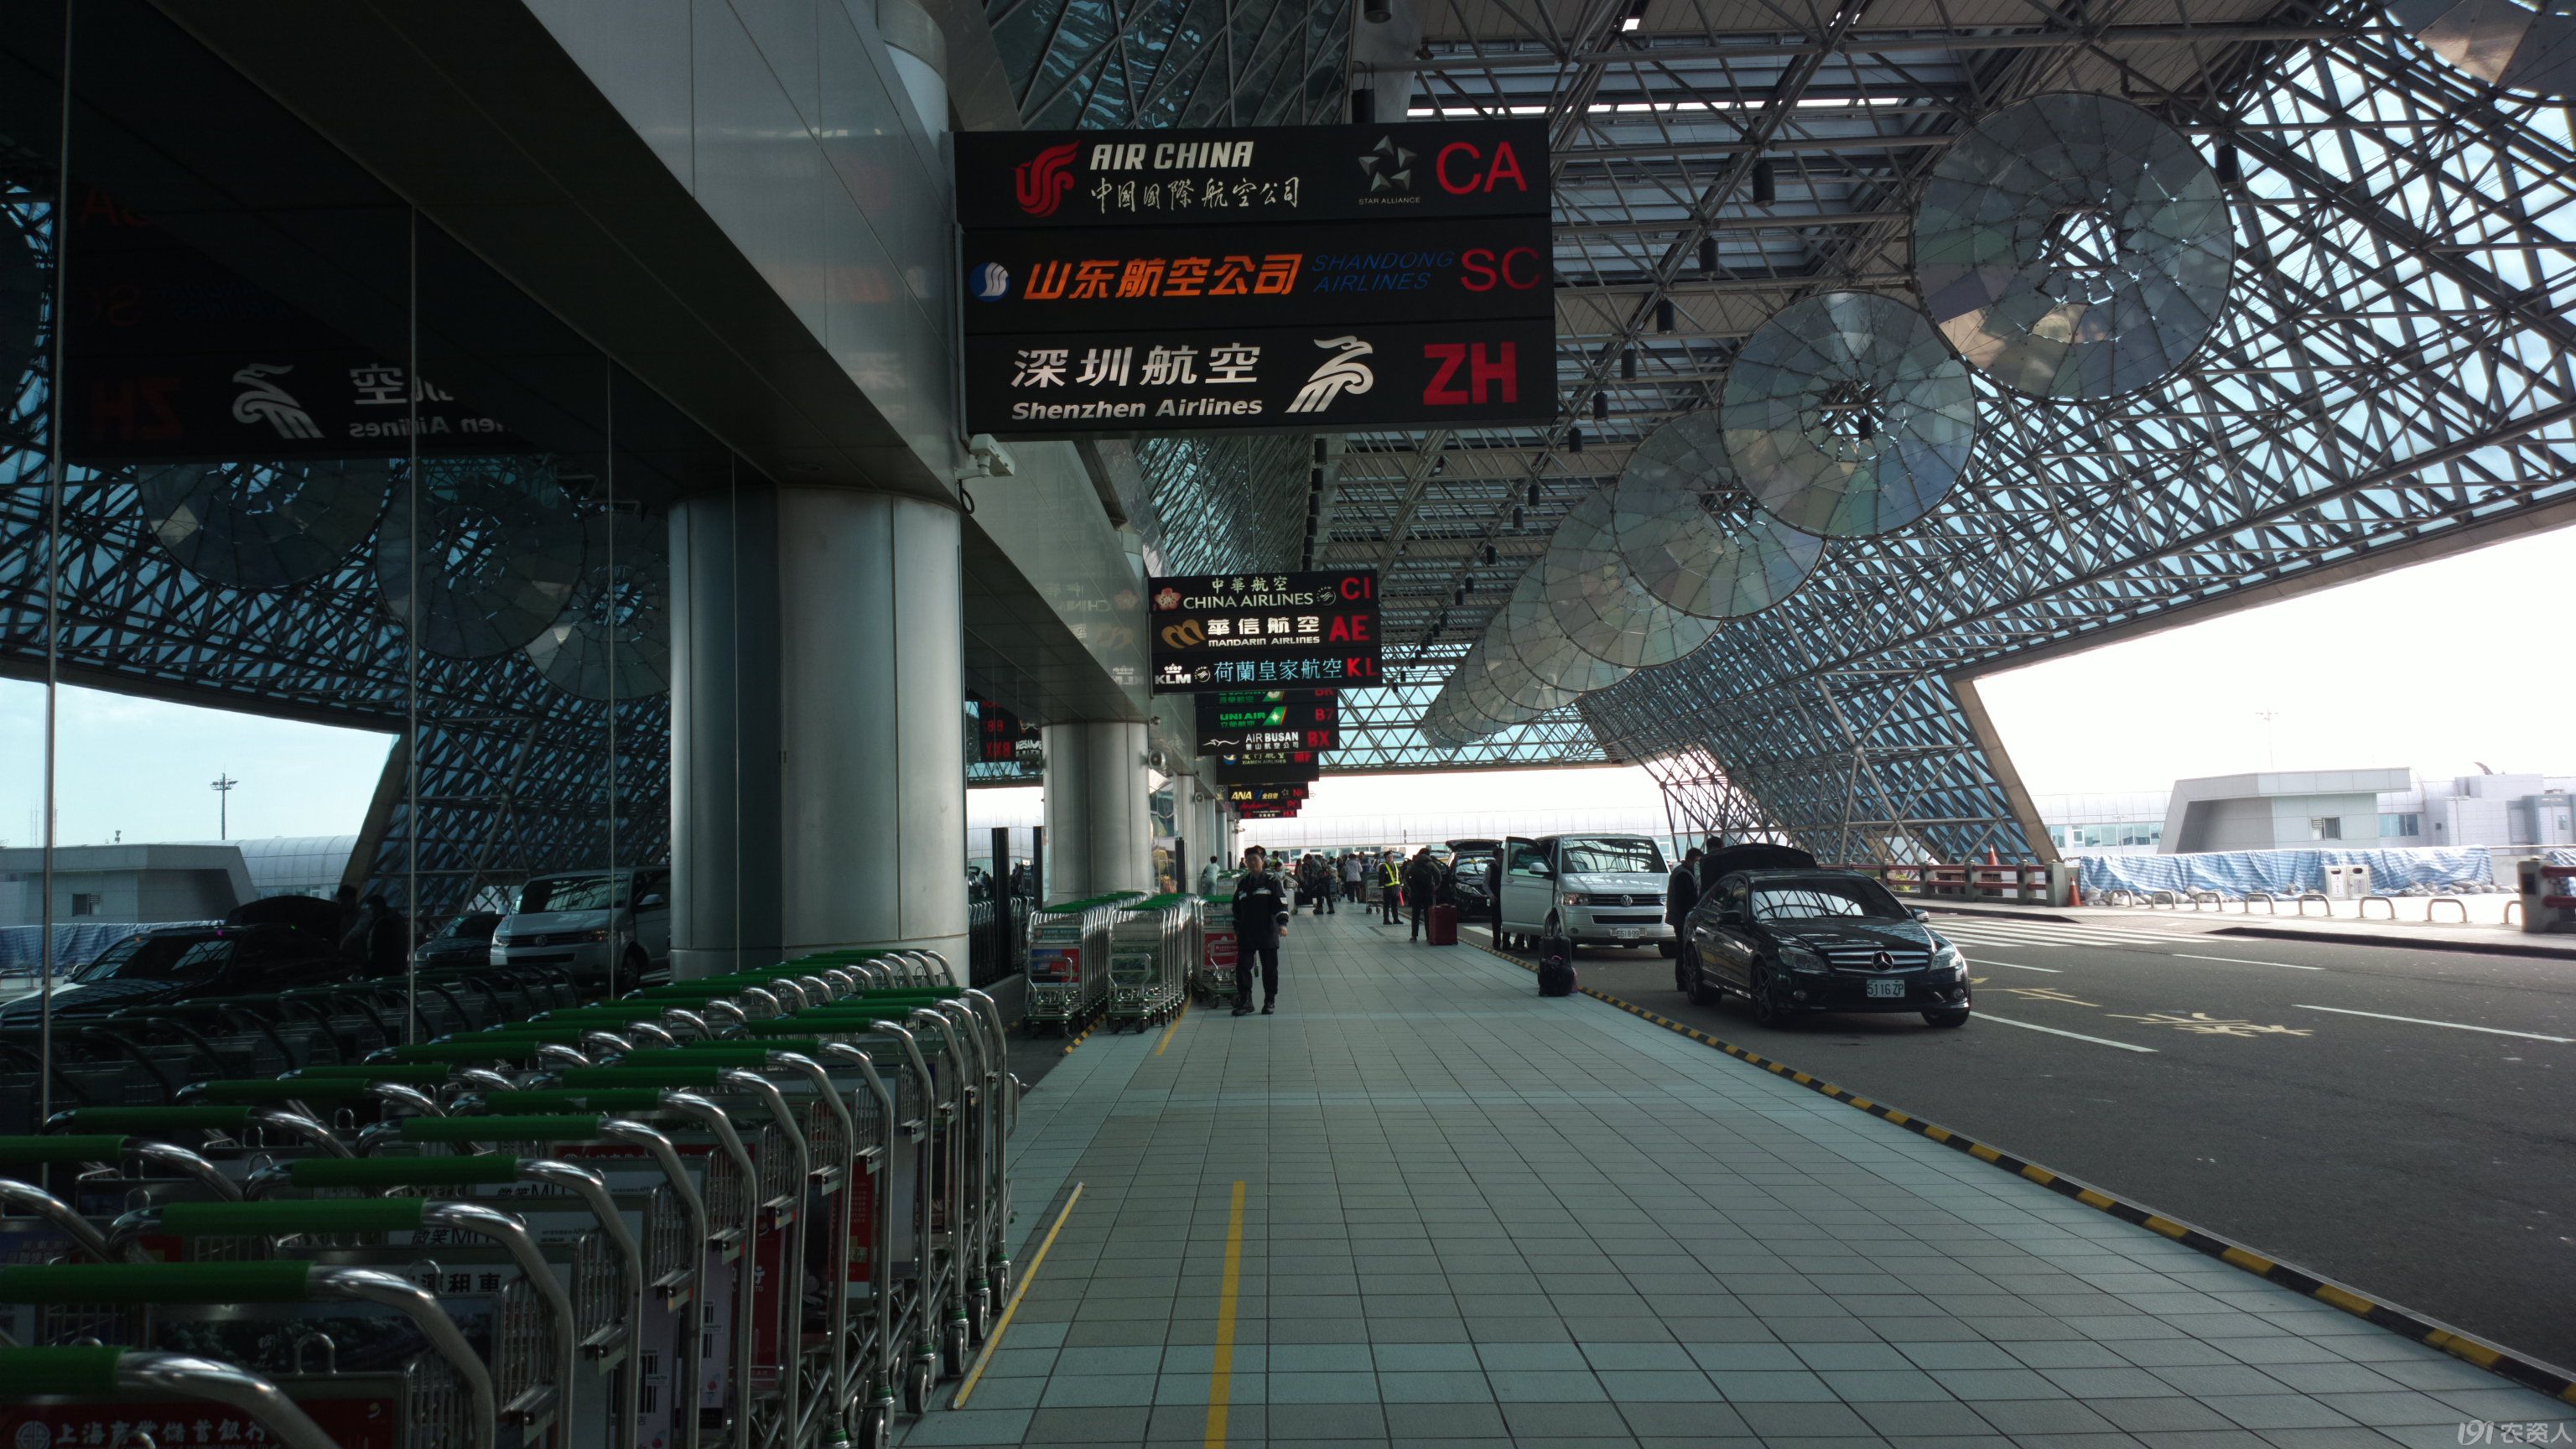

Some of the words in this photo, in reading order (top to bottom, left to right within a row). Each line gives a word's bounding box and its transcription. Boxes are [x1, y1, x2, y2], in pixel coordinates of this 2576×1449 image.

[1090, 143, 1146, 170] AIR
[1154, 141, 1254, 169] CHINA
[1436, 141, 1528, 195] CA
[1311, 251, 1455, 273] SHANDONG
[1461, 248, 1540, 292] SC
[1022, 252, 1303, 300] 山东航空公司
[1313, 271, 1431, 293] AIRLINES
[1010, 342, 1261, 388] 深圳航空
[1423, 342, 1519, 406] ZH
[1011, 401, 1146, 420] Shenzhen
[1155, 398, 1263, 417] Airlines
[1212, 576, 1288, 594] 中華航空
[1340, 577, 1372, 600] CI
[1183, 595, 1237, 610] CHINA
[1240, 592, 1314, 607] AIRLINES
[1208, 616, 1321, 636] 華信航空
[1328, 615, 1371, 642] AE
[1208, 638, 1266, 647] MANDARIN
[1270, 636, 1320, 645] AIRLINES
[1213, 657, 1342, 683] 荷蘭皇家航空
[1346, 657, 1379, 678] KL
[1155, 673, 1192, 685] KLM
[1245, 733, 1263, 743] AIR
[1265, 731, 1299, 742] BUSAN
[1307, 730, 1330, 747] BX
[1231, 791, 1252, 800] ANA
